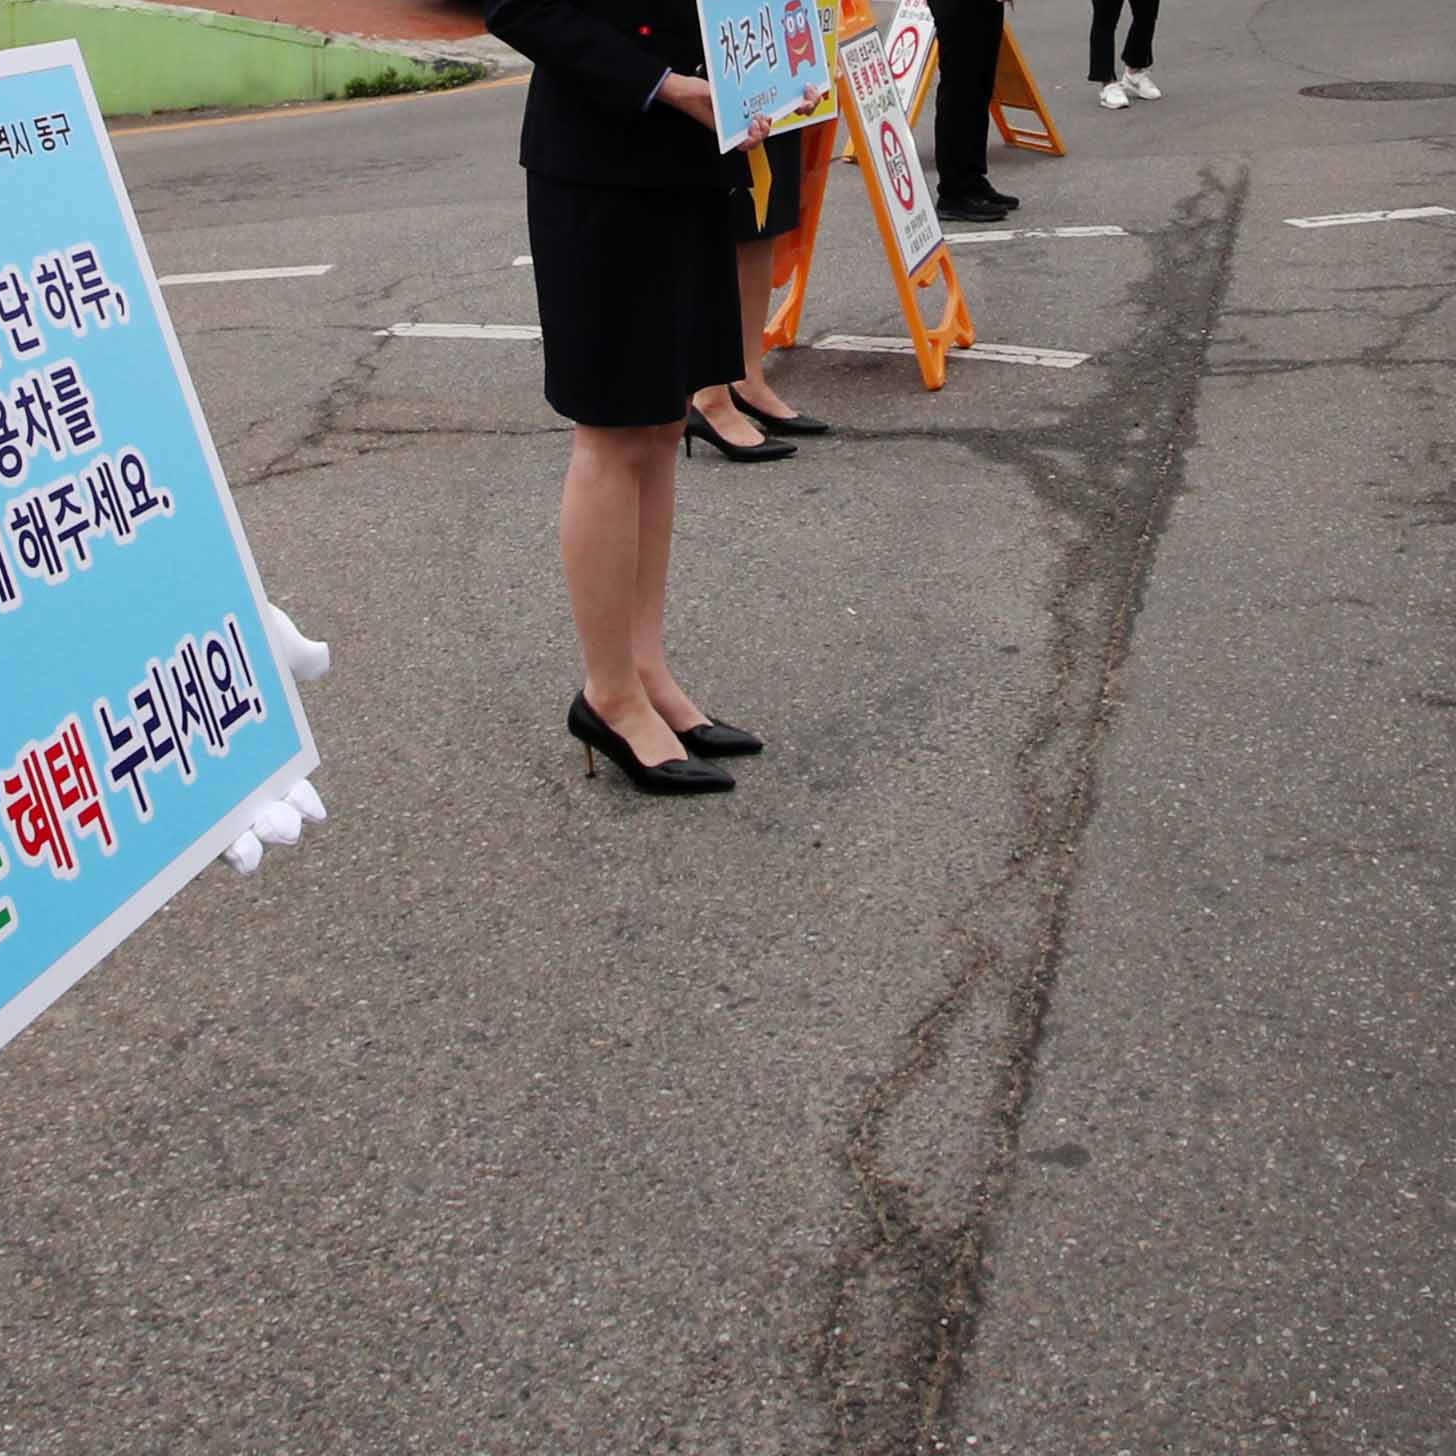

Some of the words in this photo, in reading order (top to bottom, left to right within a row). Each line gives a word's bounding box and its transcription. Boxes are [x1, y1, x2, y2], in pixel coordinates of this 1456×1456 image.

[720, 5, 778, 85] 차조심
[33, 112, 73, 156] 동구
[36, 248, 127, 331] 하루,
[9, 452, 173, 579] 해주세요.
[2, 722, 114, 870] 혜택
[99, 620, 262, 814] 누리세요!
